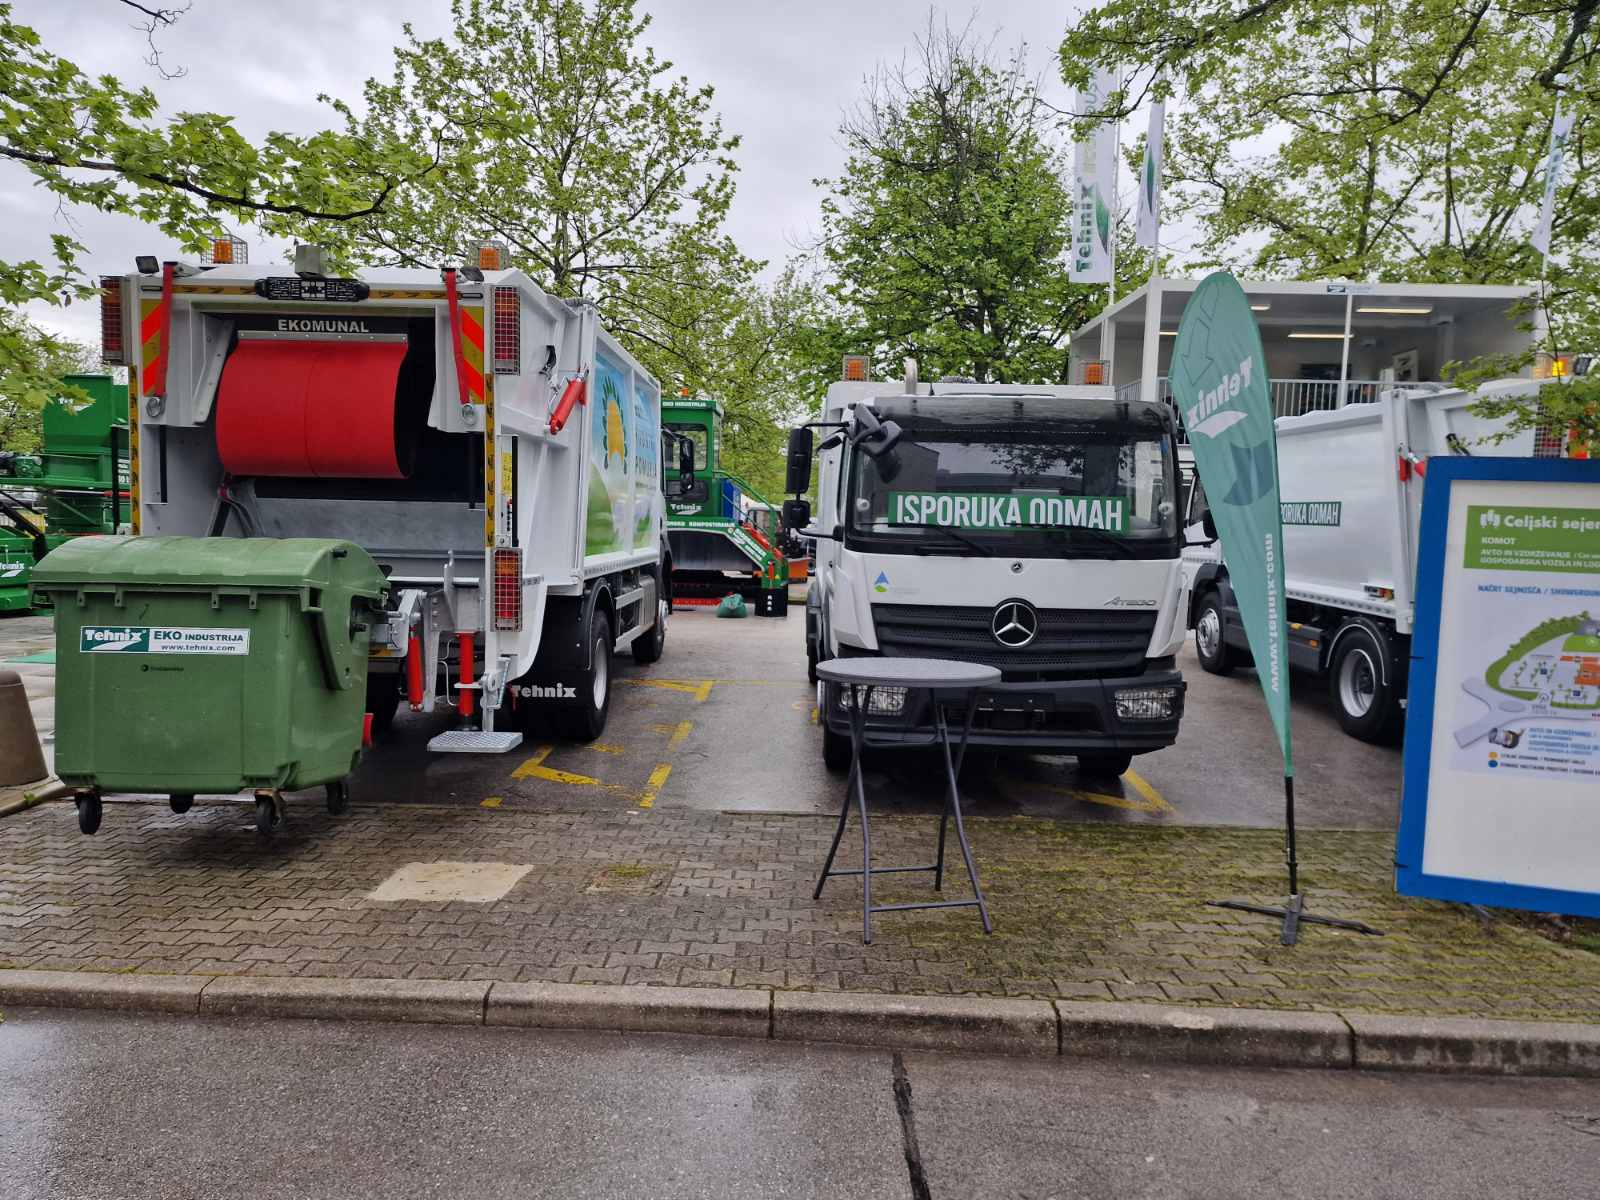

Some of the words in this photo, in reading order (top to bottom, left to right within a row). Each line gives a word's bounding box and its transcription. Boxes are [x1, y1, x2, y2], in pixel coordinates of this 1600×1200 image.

[278, 319, 369, 333] EKOMUNAL
[897, 494, 1021, 527] ISPORUKA
[1030, 498, 1122, 531] ODMAH
[1503, 514, 1557, 531] Celjski
[153, 630, 182, 641] EKO
[184, 634, 244, 642] INDUSTRIJA
[160, 643, 236, 652] www.tehnix.com
[511, 683, 577, 698] Tehnix
